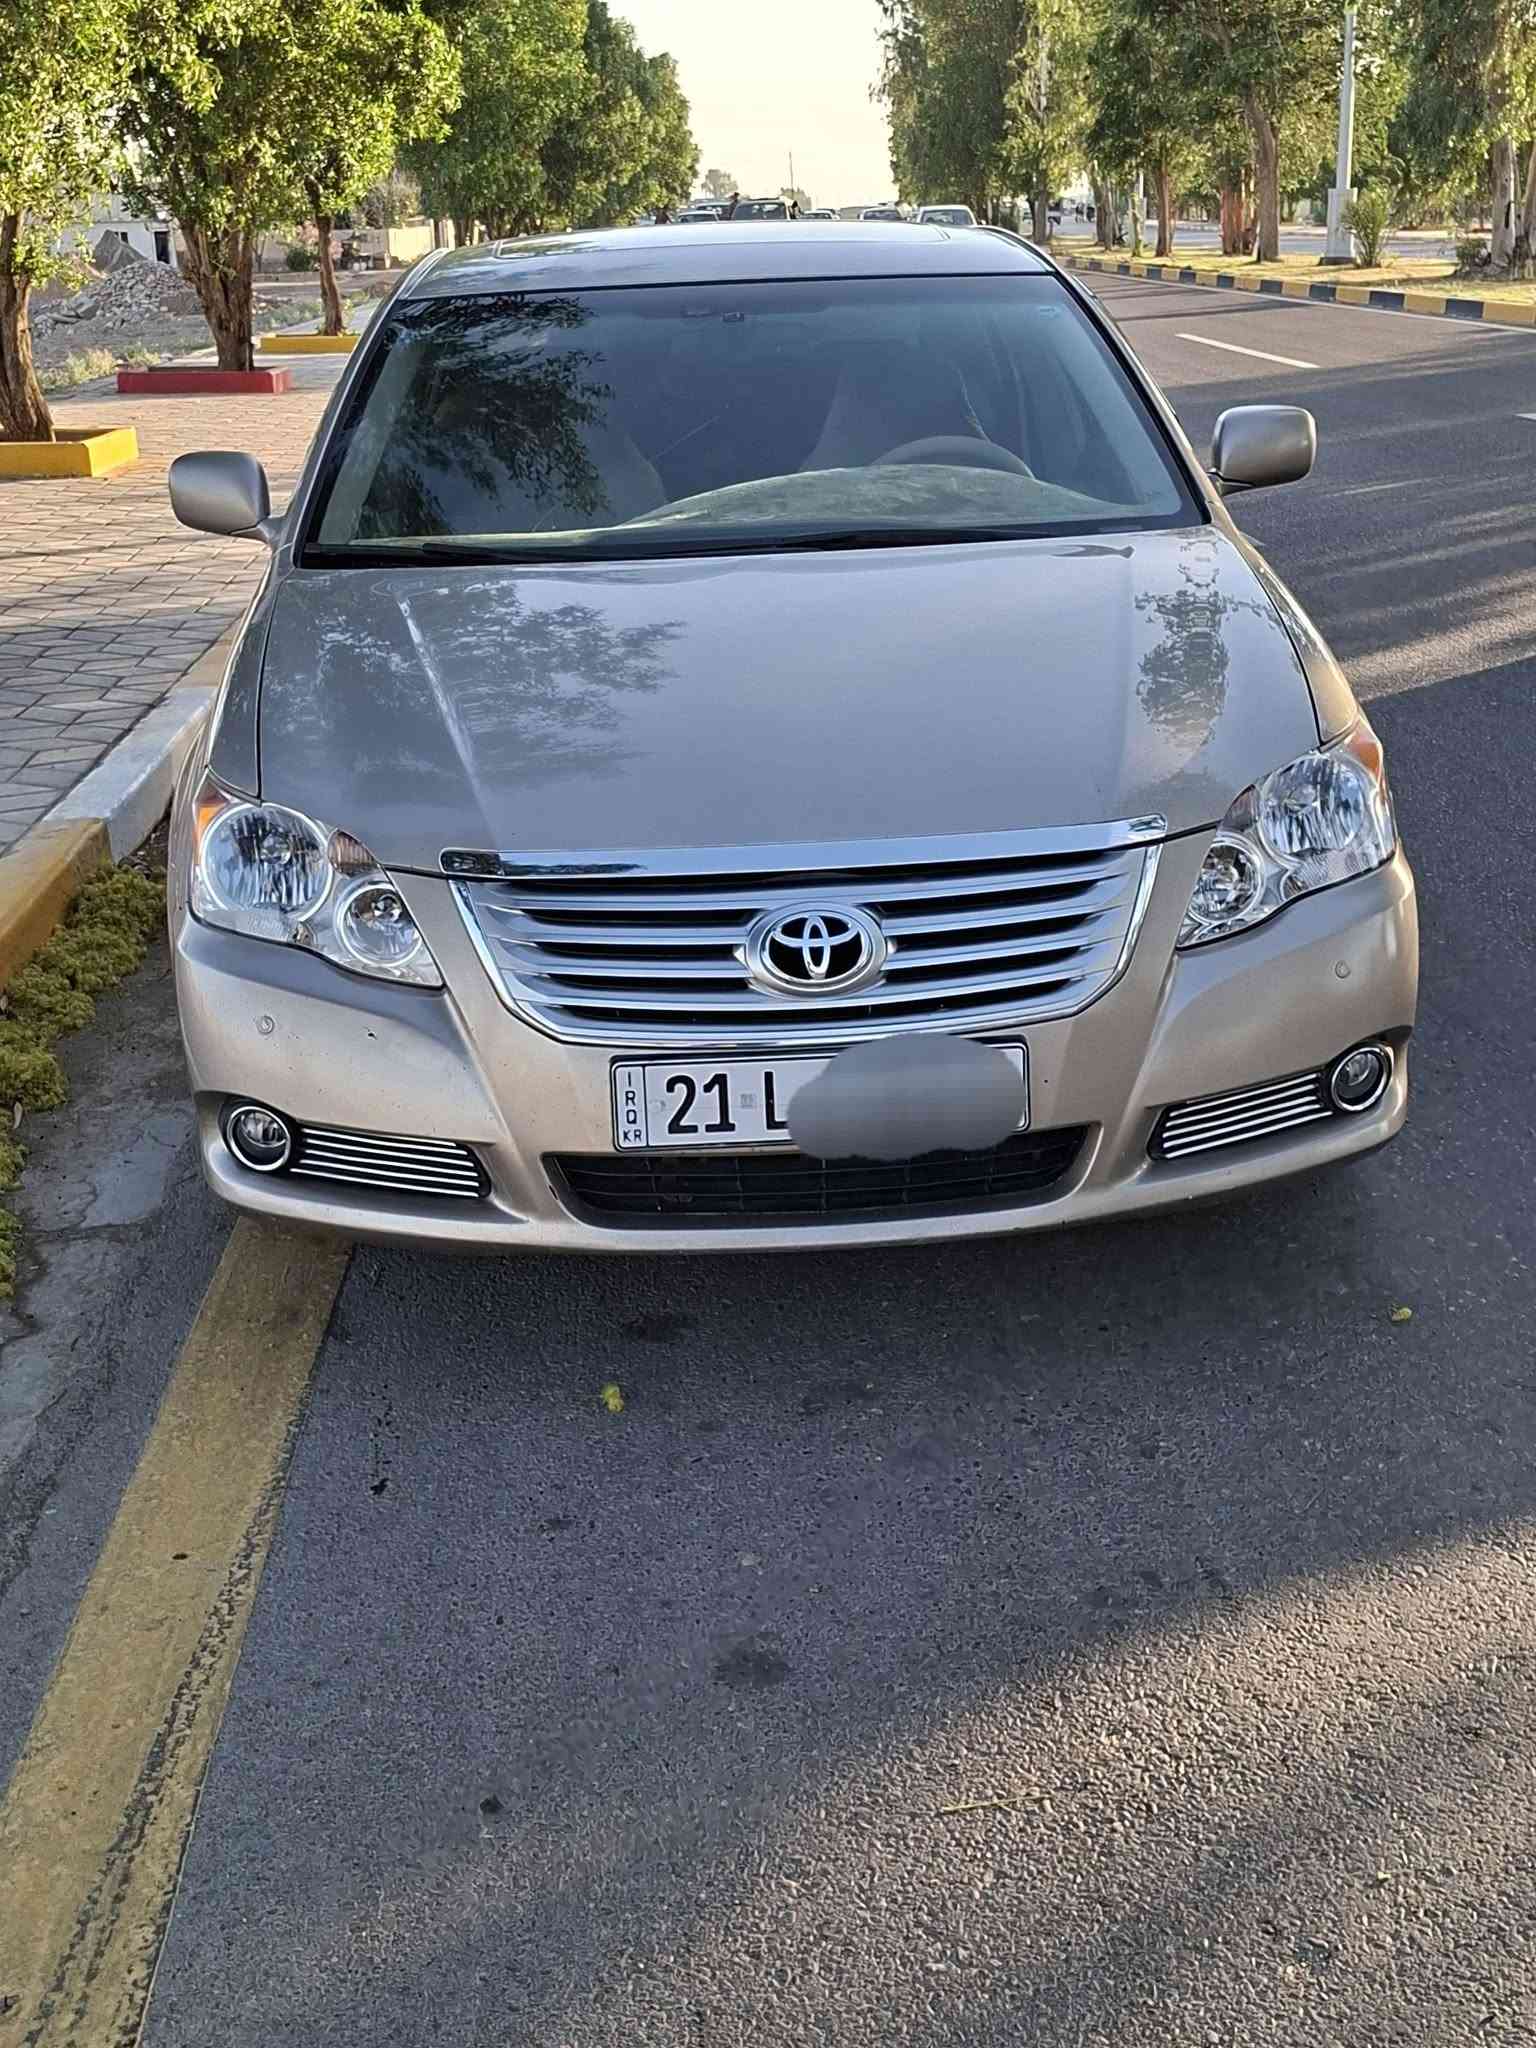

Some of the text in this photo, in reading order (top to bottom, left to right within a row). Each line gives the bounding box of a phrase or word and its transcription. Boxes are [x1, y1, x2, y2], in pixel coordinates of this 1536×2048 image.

[624, 1071, 638, 1125] IRQ
[665, 1072, 736, 1135] 21
[623, 1129, 642, 1142] KR
